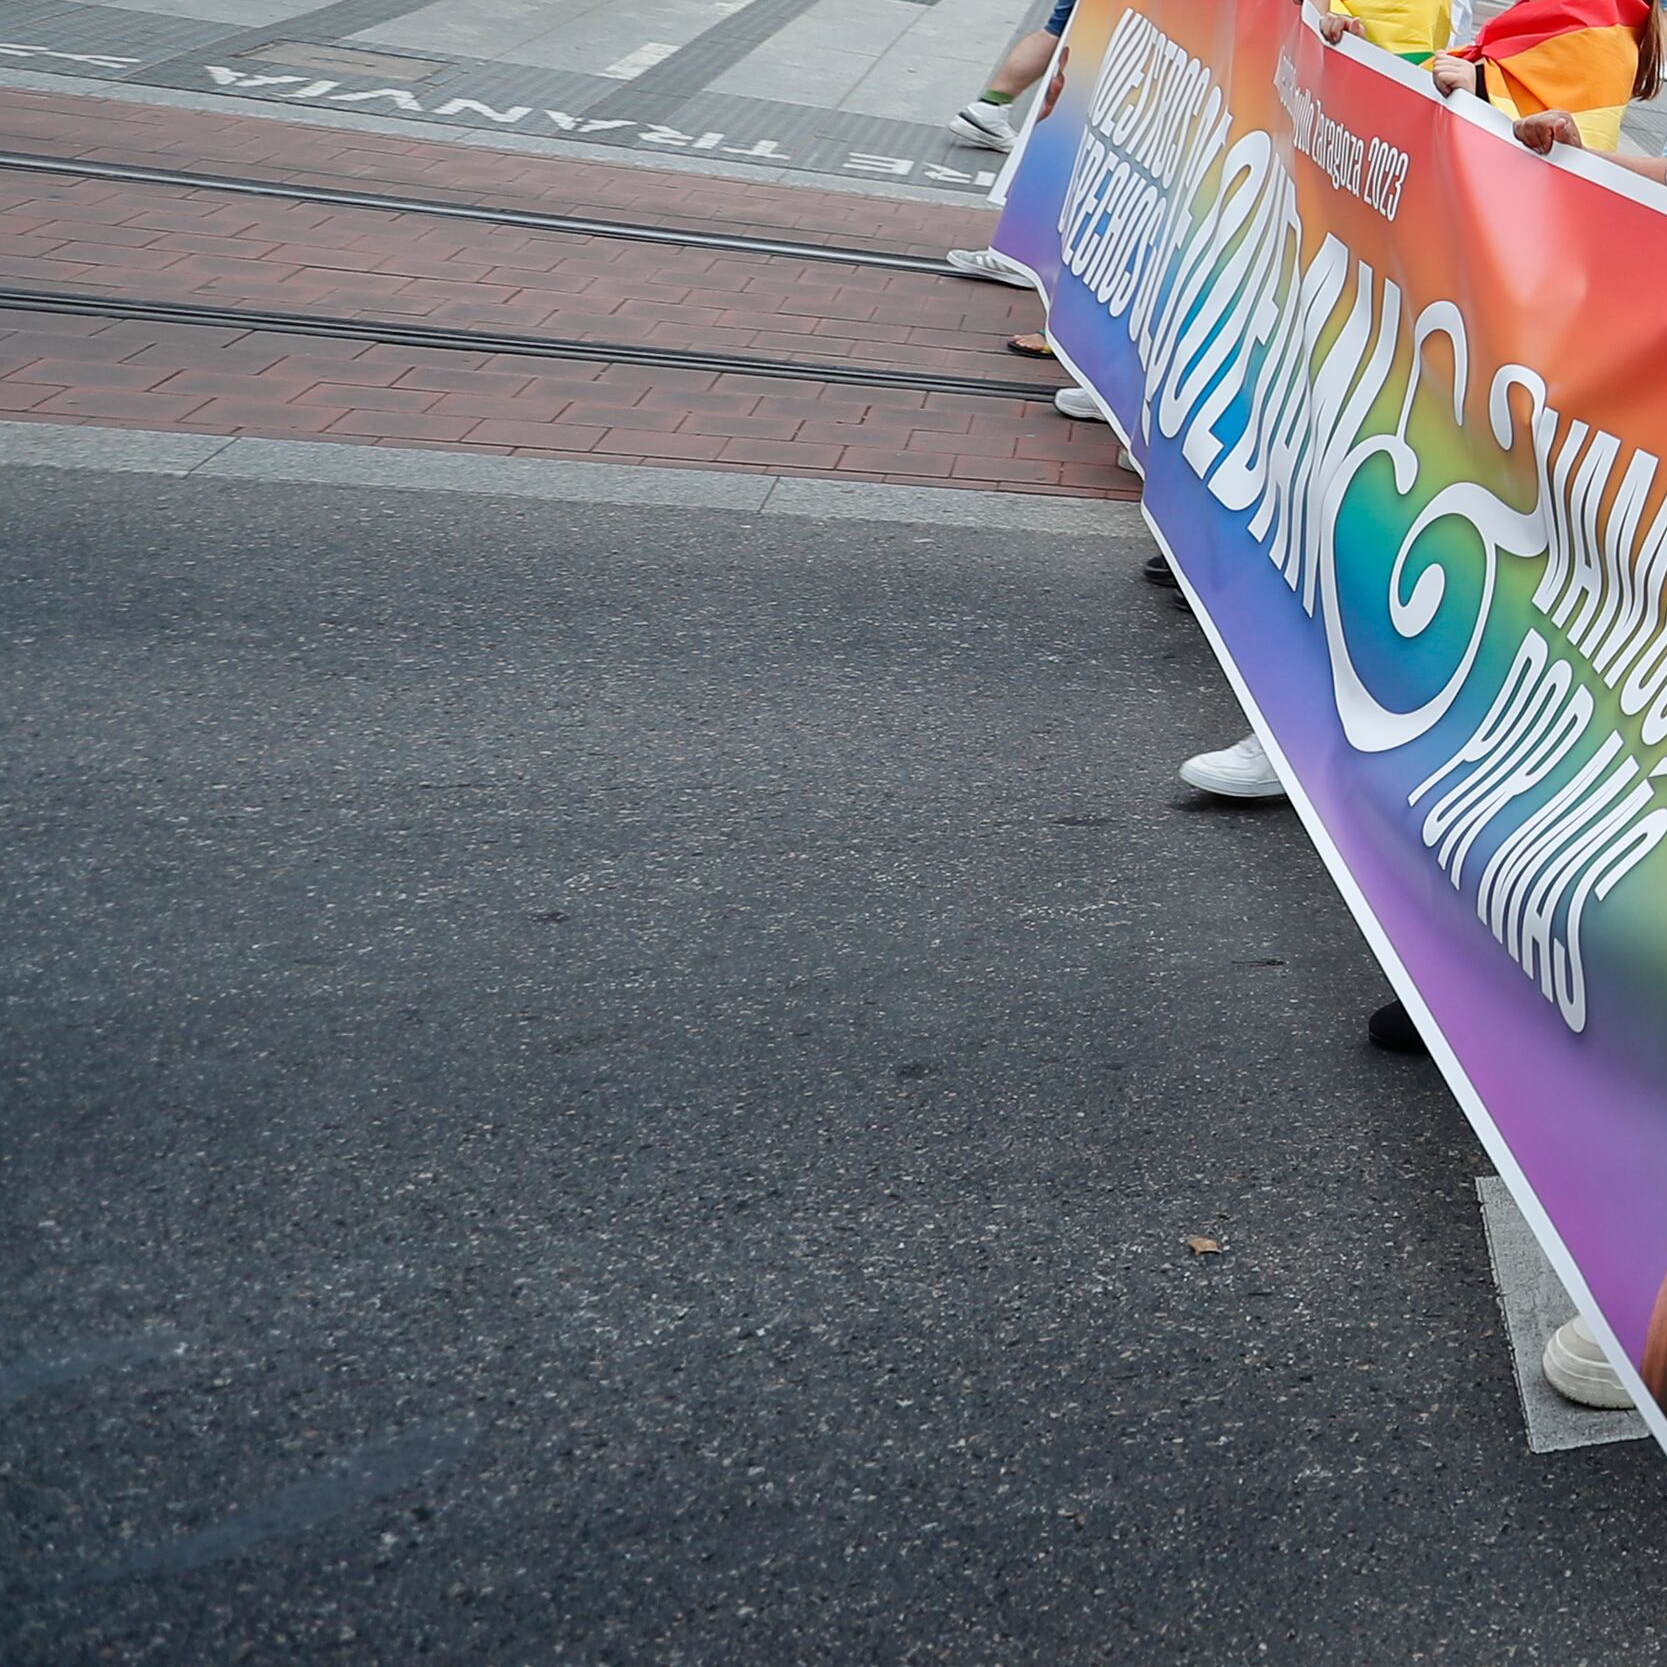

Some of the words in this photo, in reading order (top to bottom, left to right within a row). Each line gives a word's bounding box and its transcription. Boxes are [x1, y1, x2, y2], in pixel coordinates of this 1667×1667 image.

[1088, 7, 1211, 191] NUESTROS
[1311, 99, 1364, 198] Zaragoza
[1363, 137, 1409, 222] 2023
[1145, 130, 1401, 618] QUEDAN
[1408, 628, 1595, 891] POR
